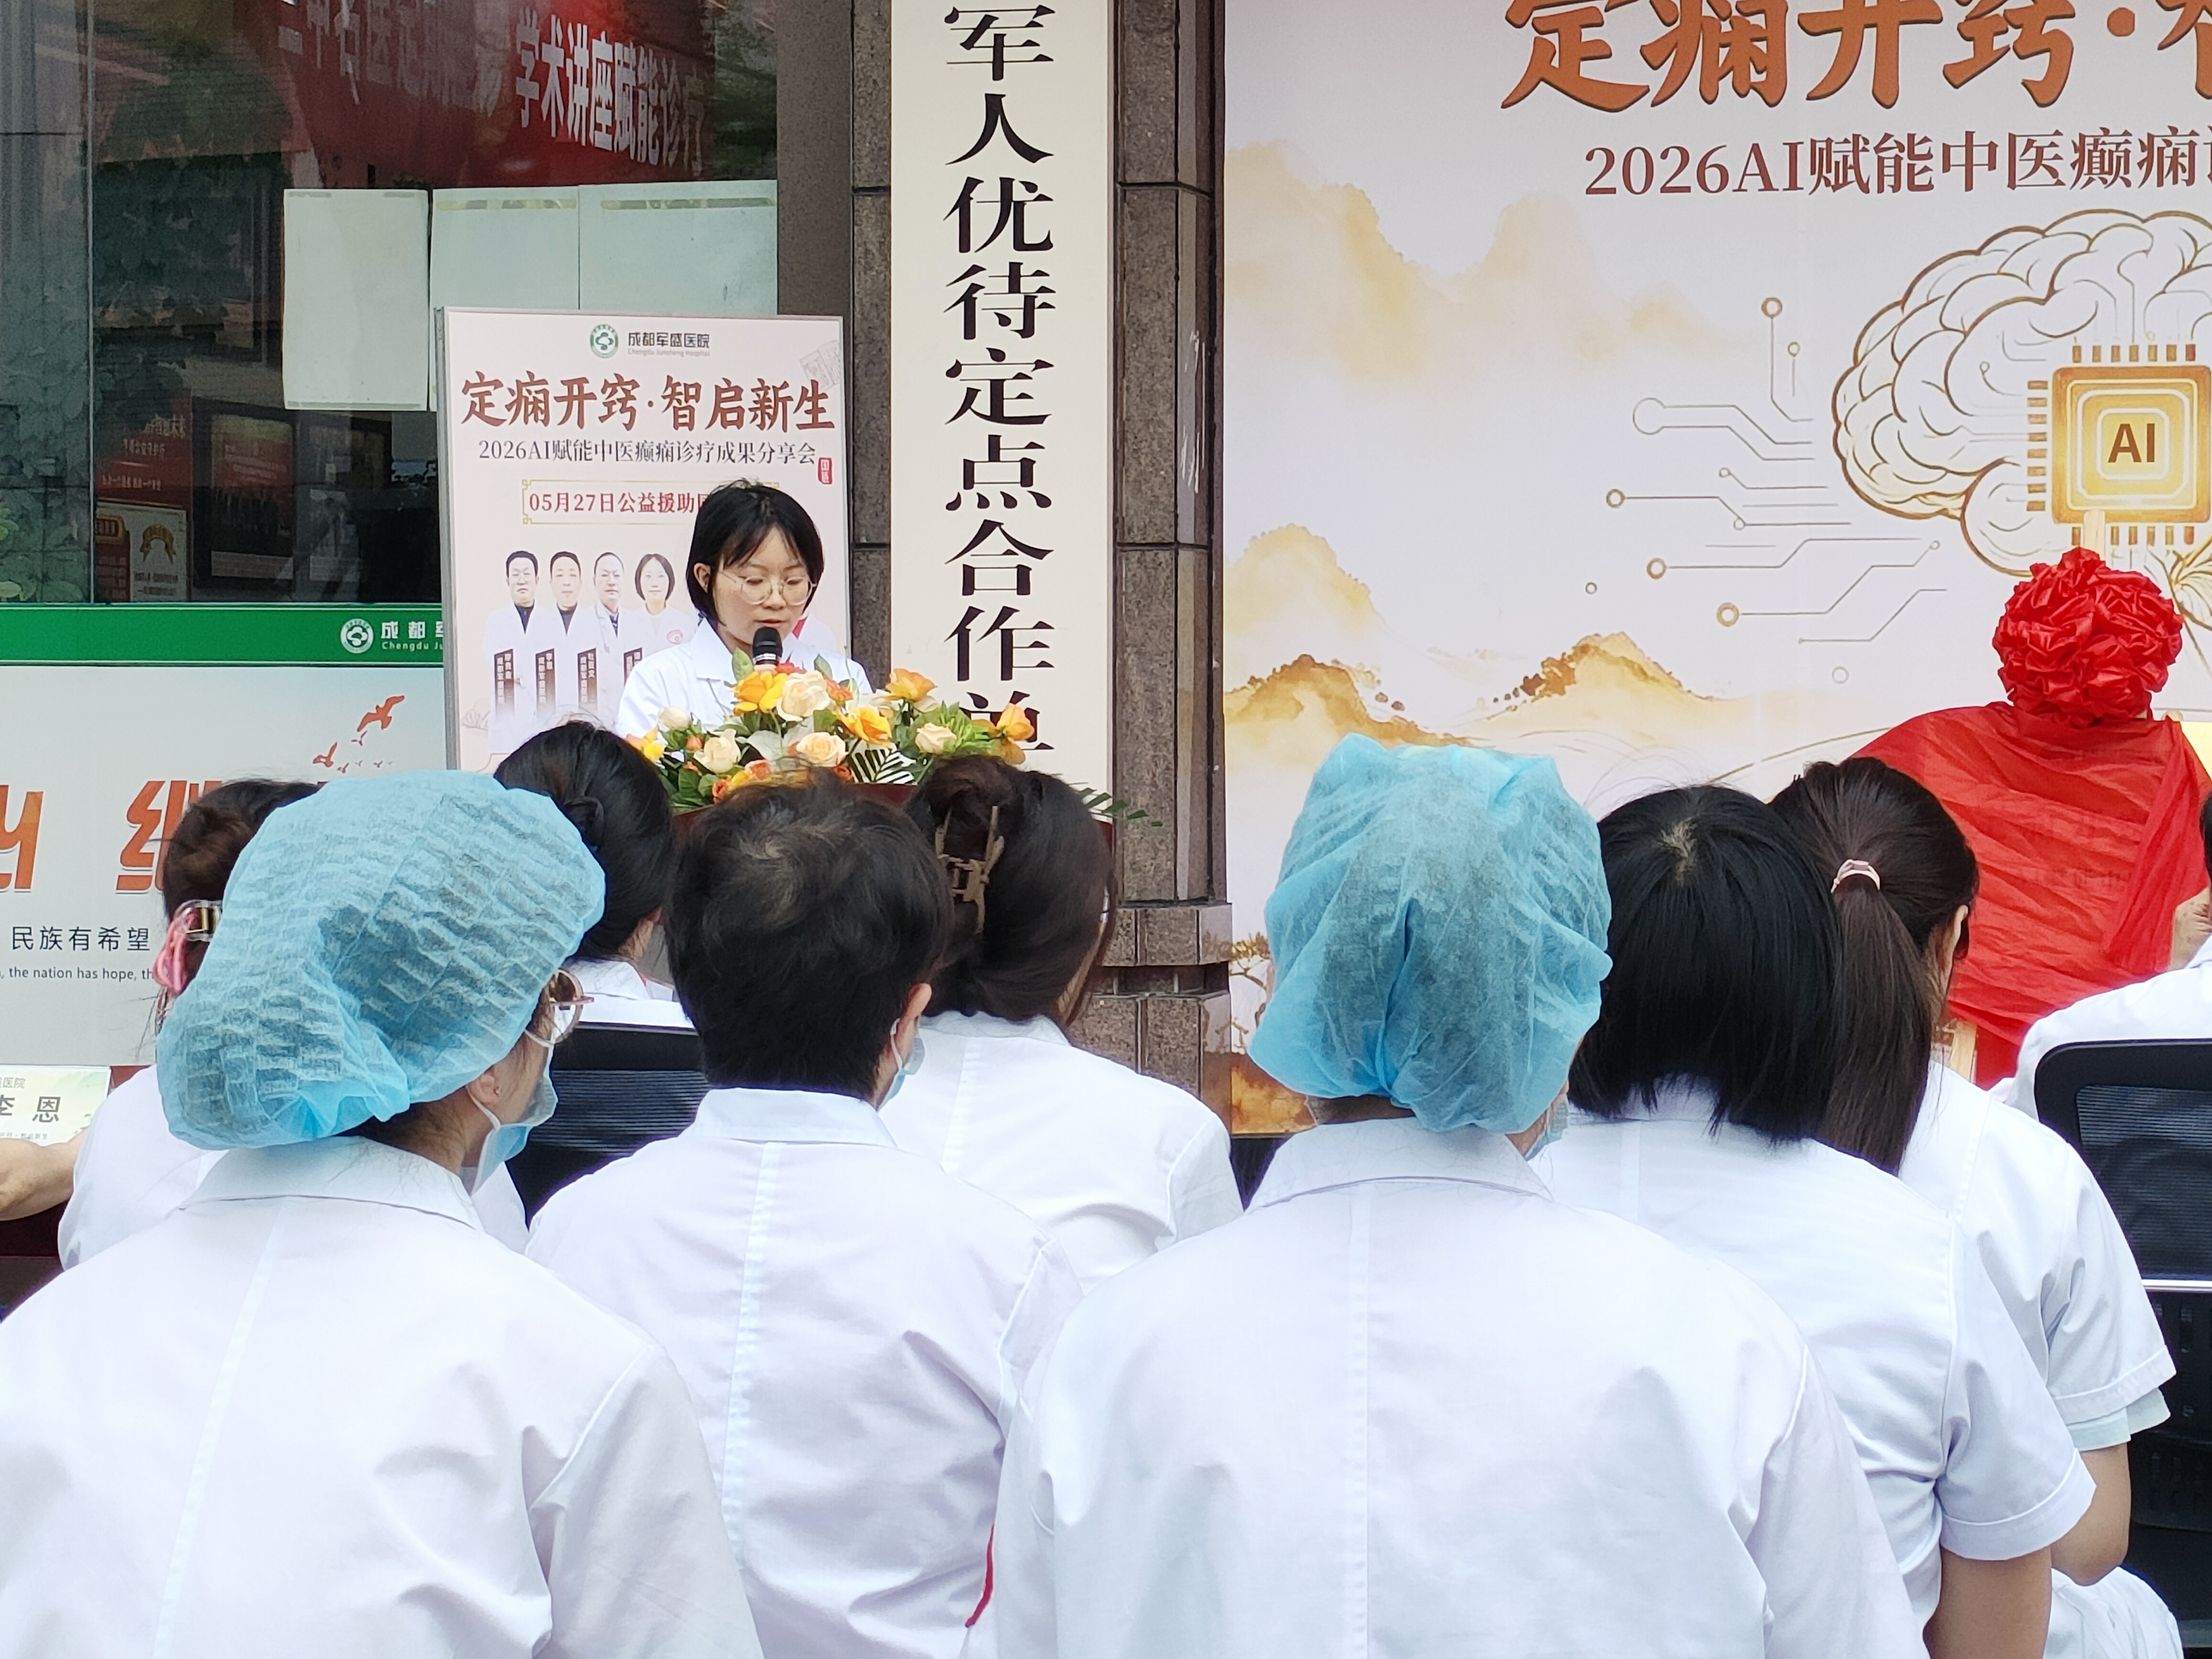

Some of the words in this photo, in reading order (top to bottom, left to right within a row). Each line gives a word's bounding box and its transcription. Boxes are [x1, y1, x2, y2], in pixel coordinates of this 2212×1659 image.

[1500, 0, 2212, 113] 定痫开窍·
[1584, 125, 2212, 195] 2026AI赋能中医癫痫
[628, 332, 710, 348] 成都军盛医院
[461, 370, 835, 433] 定痫开窍·智启新生
[479, 439, 816, 465] 2026AI赋能中医癫痫诊疗成果分享会
[2108, 423, 2156, 463] AI
[382, 641, 429, 651] Chengdu
[12, 926, 150, 951] 民族有希望
[9, 966, 29, 978] the
[33, 967, 72, 978] nation
[77, 967, 98, 979] has
[102, 968, 137, 982] hope,
[0, 1077, 26, 1088] 医院
